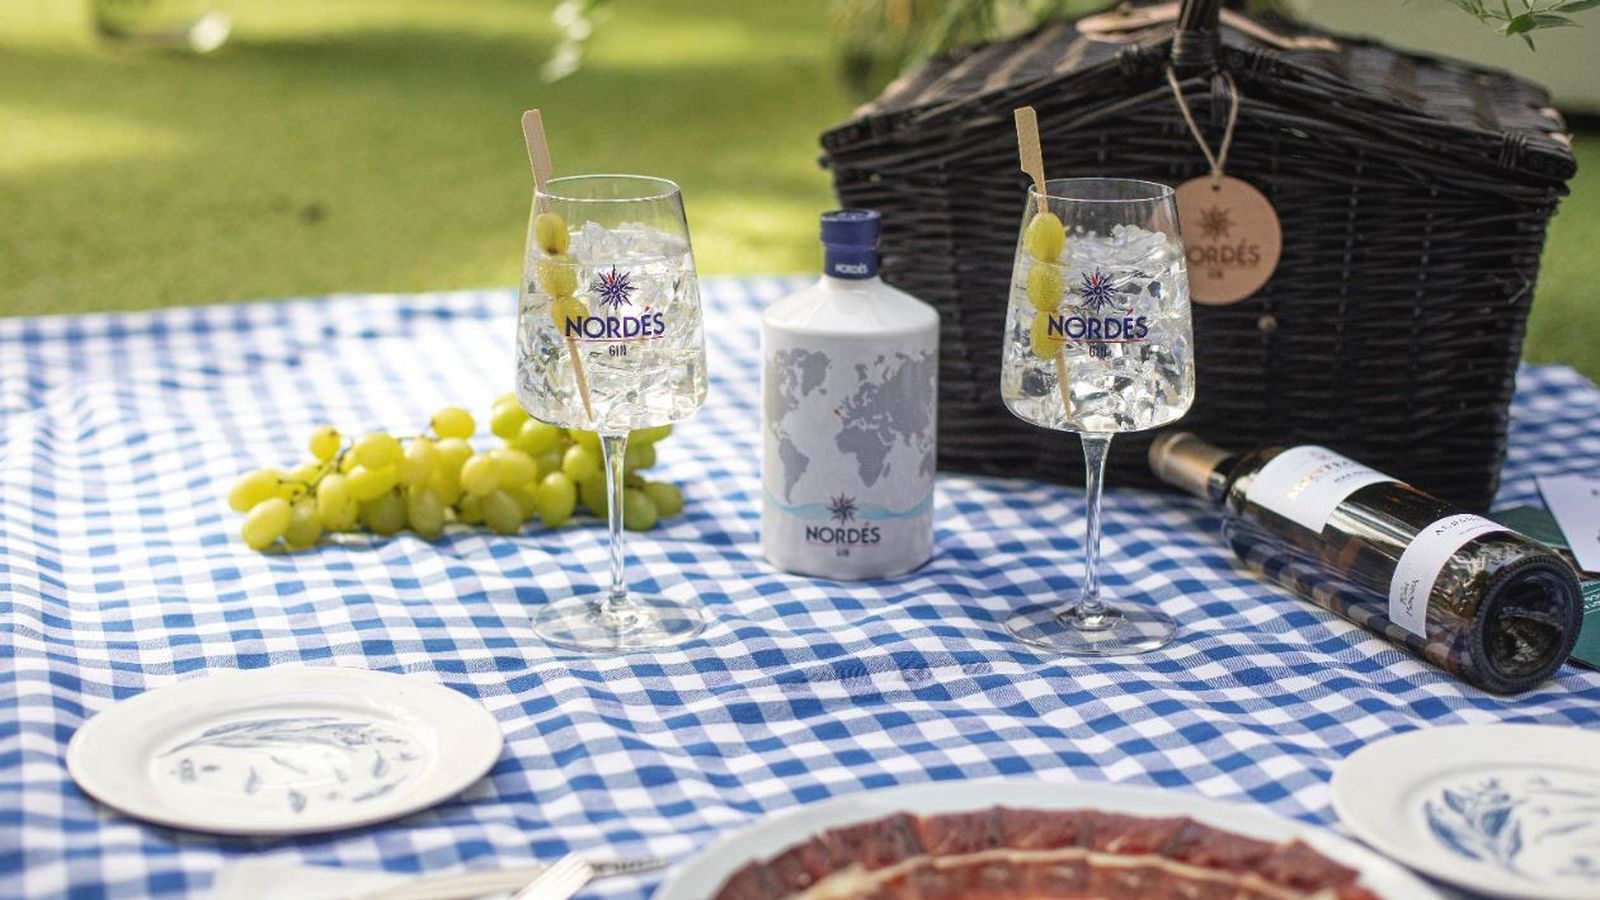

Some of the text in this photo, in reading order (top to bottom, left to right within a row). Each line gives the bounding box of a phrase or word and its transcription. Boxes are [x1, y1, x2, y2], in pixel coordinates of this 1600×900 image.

[1185, 238, 1260, 266] ORDÉS
[565, 304, 665, 338] NORDÉS
[1047, 305, 1149, 339] NORDÉS
[608, 344, 627, 356] GIN
[806, 521, 881, 544] NORDÉS
